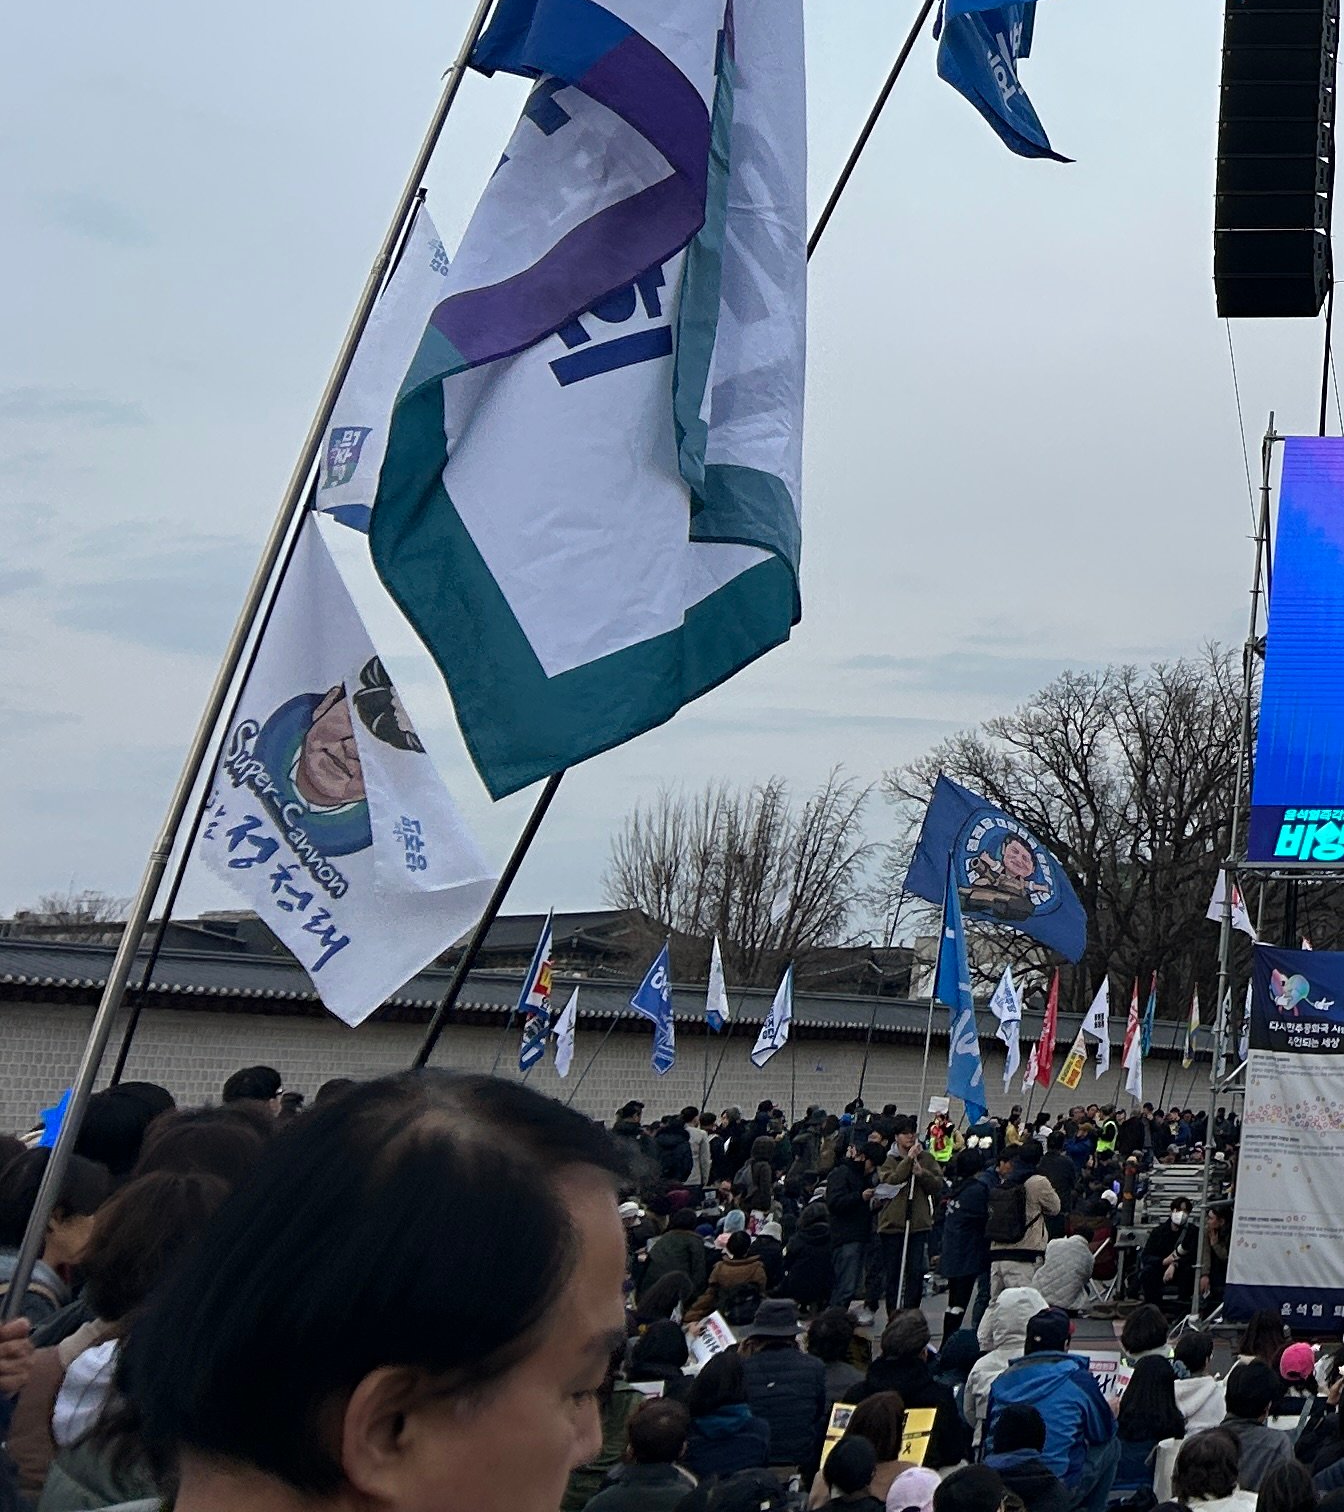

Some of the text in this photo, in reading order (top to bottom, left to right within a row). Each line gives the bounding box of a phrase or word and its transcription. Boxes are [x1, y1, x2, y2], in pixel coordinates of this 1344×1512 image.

[227, 719, 349, 898] Super-Cannon
[226, 815, 350, 972] 정청래
[1281, 1302, 1323, 1317] 윤석열
